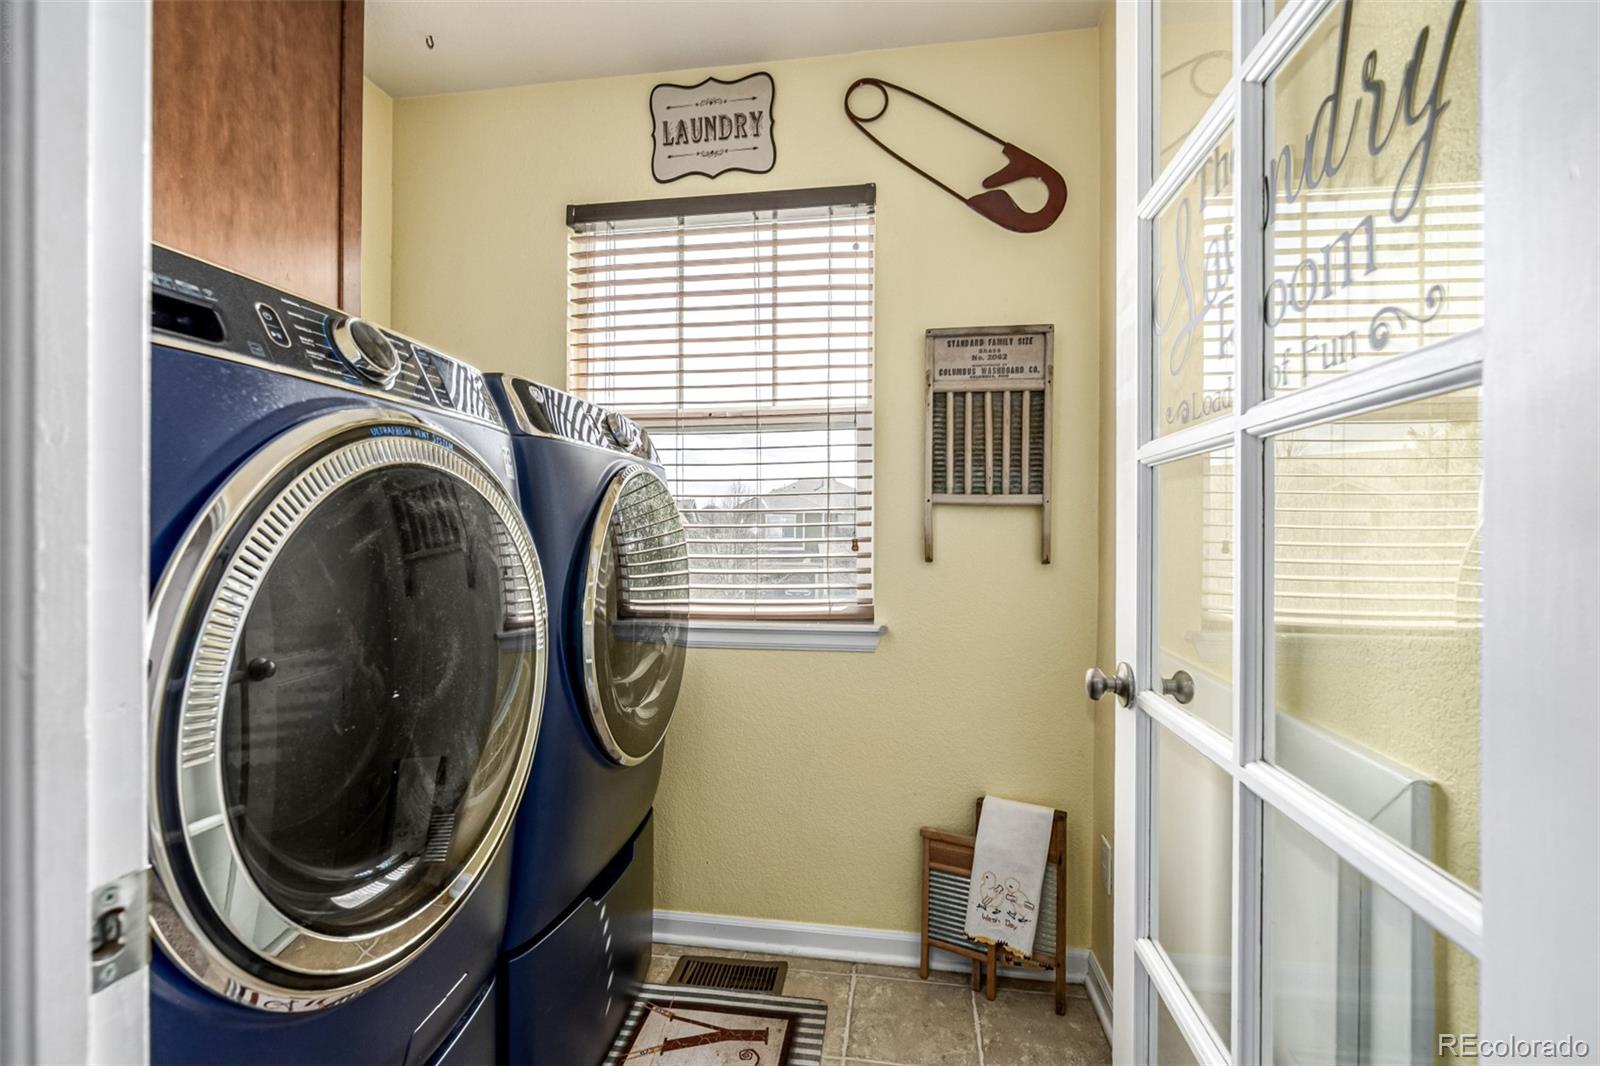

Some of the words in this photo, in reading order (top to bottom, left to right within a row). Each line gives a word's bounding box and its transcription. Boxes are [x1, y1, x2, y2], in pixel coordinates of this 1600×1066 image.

[662, 110, 763, 146] LAUNDRY
[947, 338, 984, 348] STANDARD
[988, 337, 1013, 347] FAMILY
[1018, 336, 1034, 346] SIZE
[938, 367, 976, 377] COLUMBUS
[981, 366, 1025, 375] WASHBOARD
[1029, 365, 1040, 374] CO.
[1268, 347, 1291, 391] of
[1302, 330, 1357, 379] Fun
